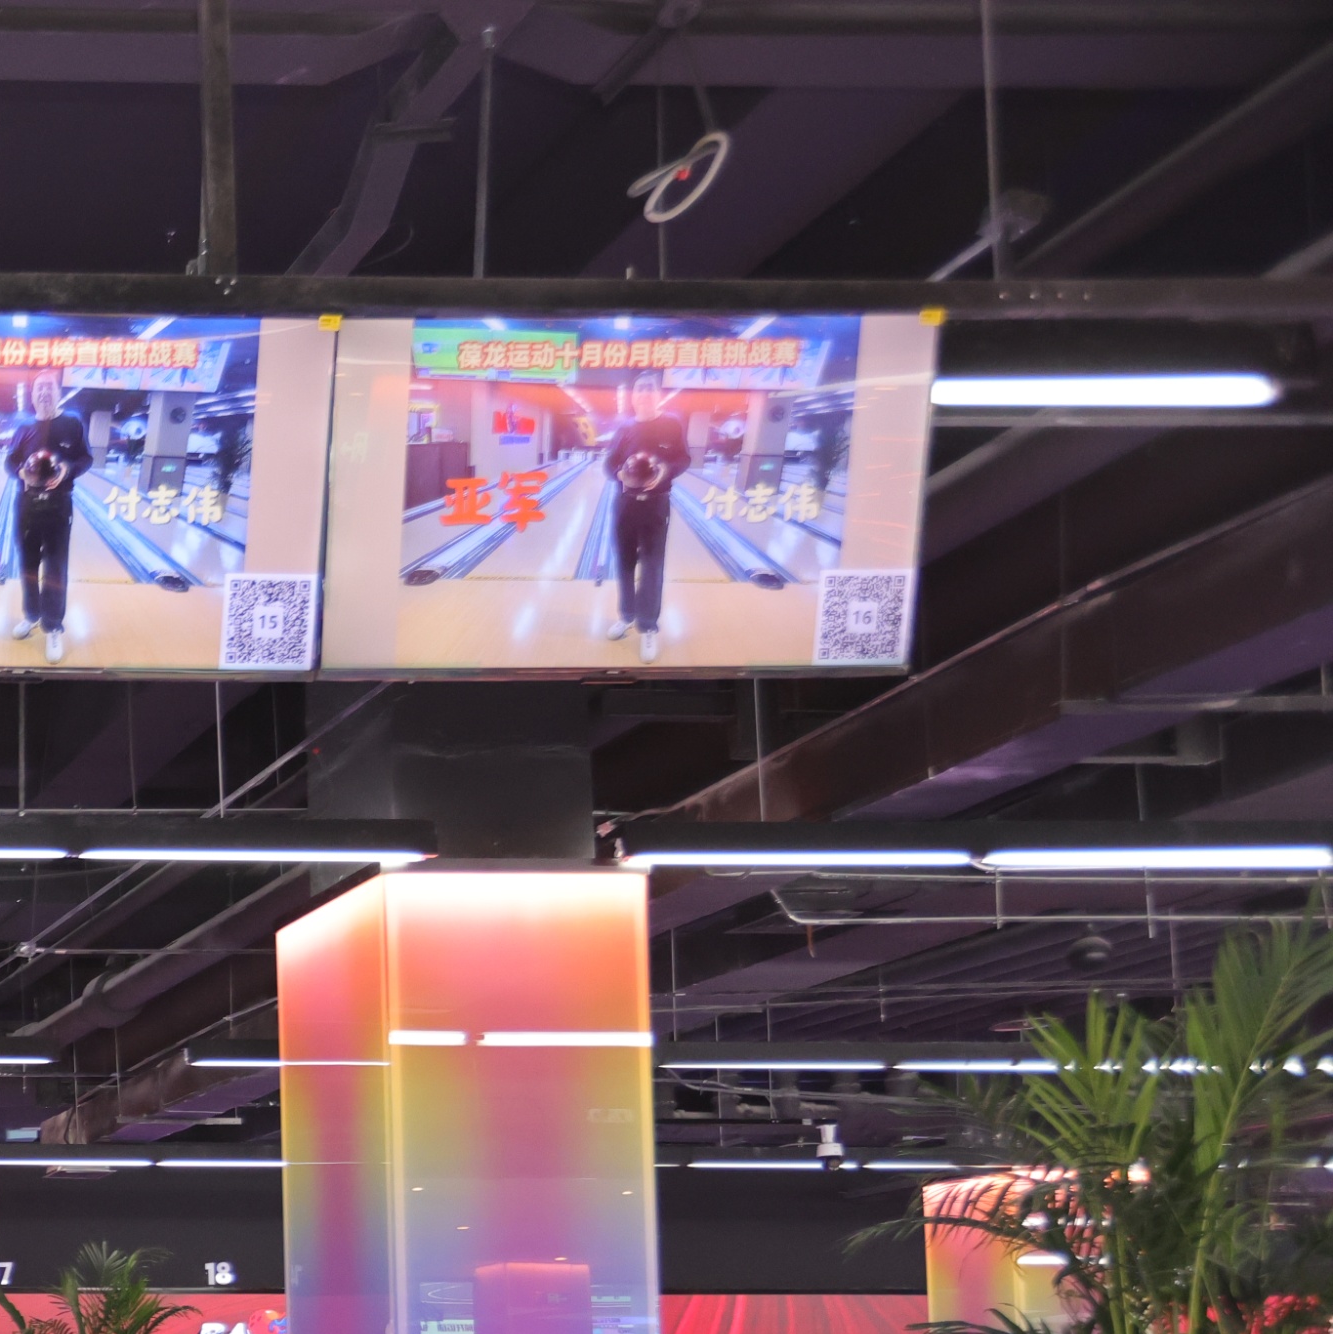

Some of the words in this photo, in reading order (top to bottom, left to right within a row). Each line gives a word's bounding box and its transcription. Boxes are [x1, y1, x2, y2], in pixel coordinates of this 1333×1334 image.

[457, 339, 798, 370] 葆龙运动十月份月榜直播挑战赛
[103, 486, 224, 526] 付志伟
[440, 470, 549, 533] 亚军
[702, 482, 821, 523] 付志伟
[258, 613, 279, 631] 15
[852, 609, 872, 626] 16
[204, 1261, 235, 1286] 18
